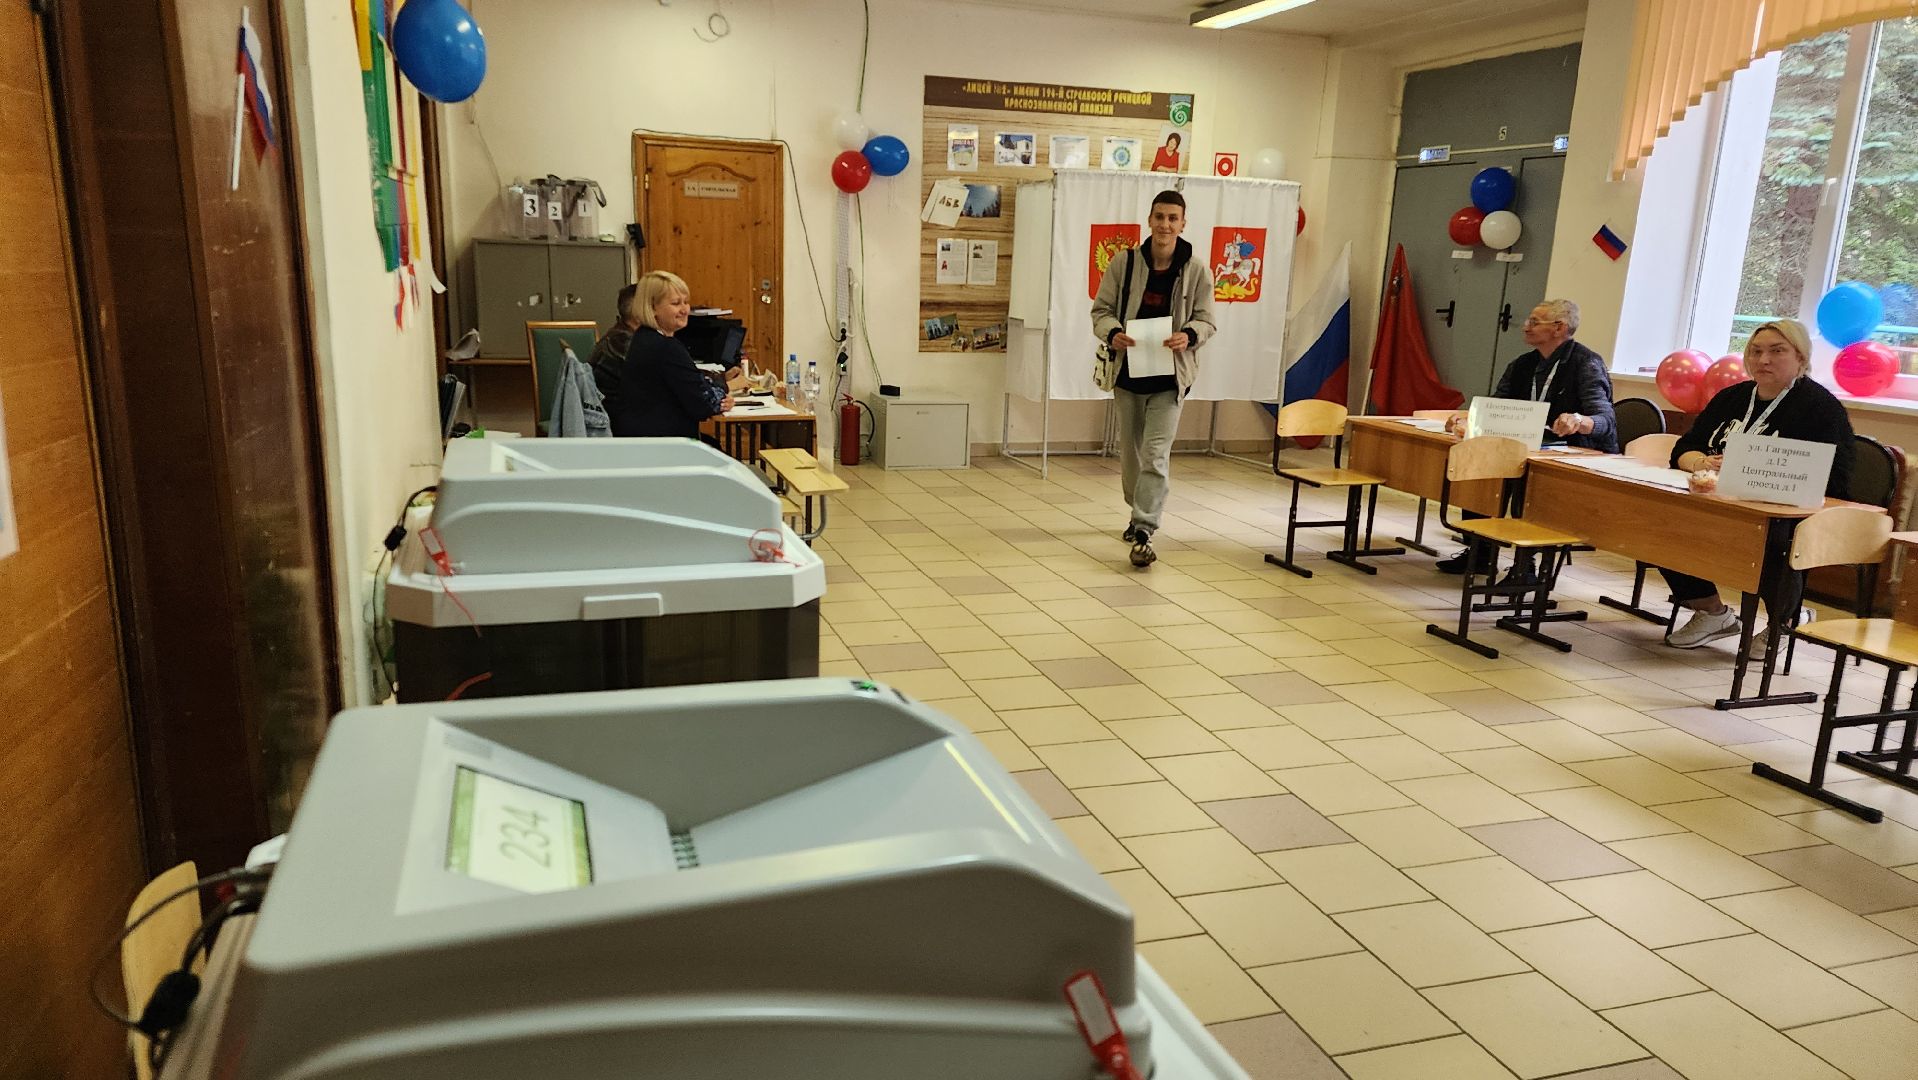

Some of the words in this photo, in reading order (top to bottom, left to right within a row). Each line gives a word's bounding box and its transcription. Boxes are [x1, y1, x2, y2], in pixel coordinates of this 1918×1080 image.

[1013, 85, 1040, 97] ИМЕНИ
[525, 198, 537, 216] 3
[939, 195, 960, 208] АБВ
[551, 206, 558, 217] 2
[1748, 444, 1763, 453] ул.
[1765, 444, 1811, 457] Гагарина
[1742, 466, 1809, 481] Центральный
[1747, 480, 1780, 490] проезд
[499, 804, 551, 869] 234
